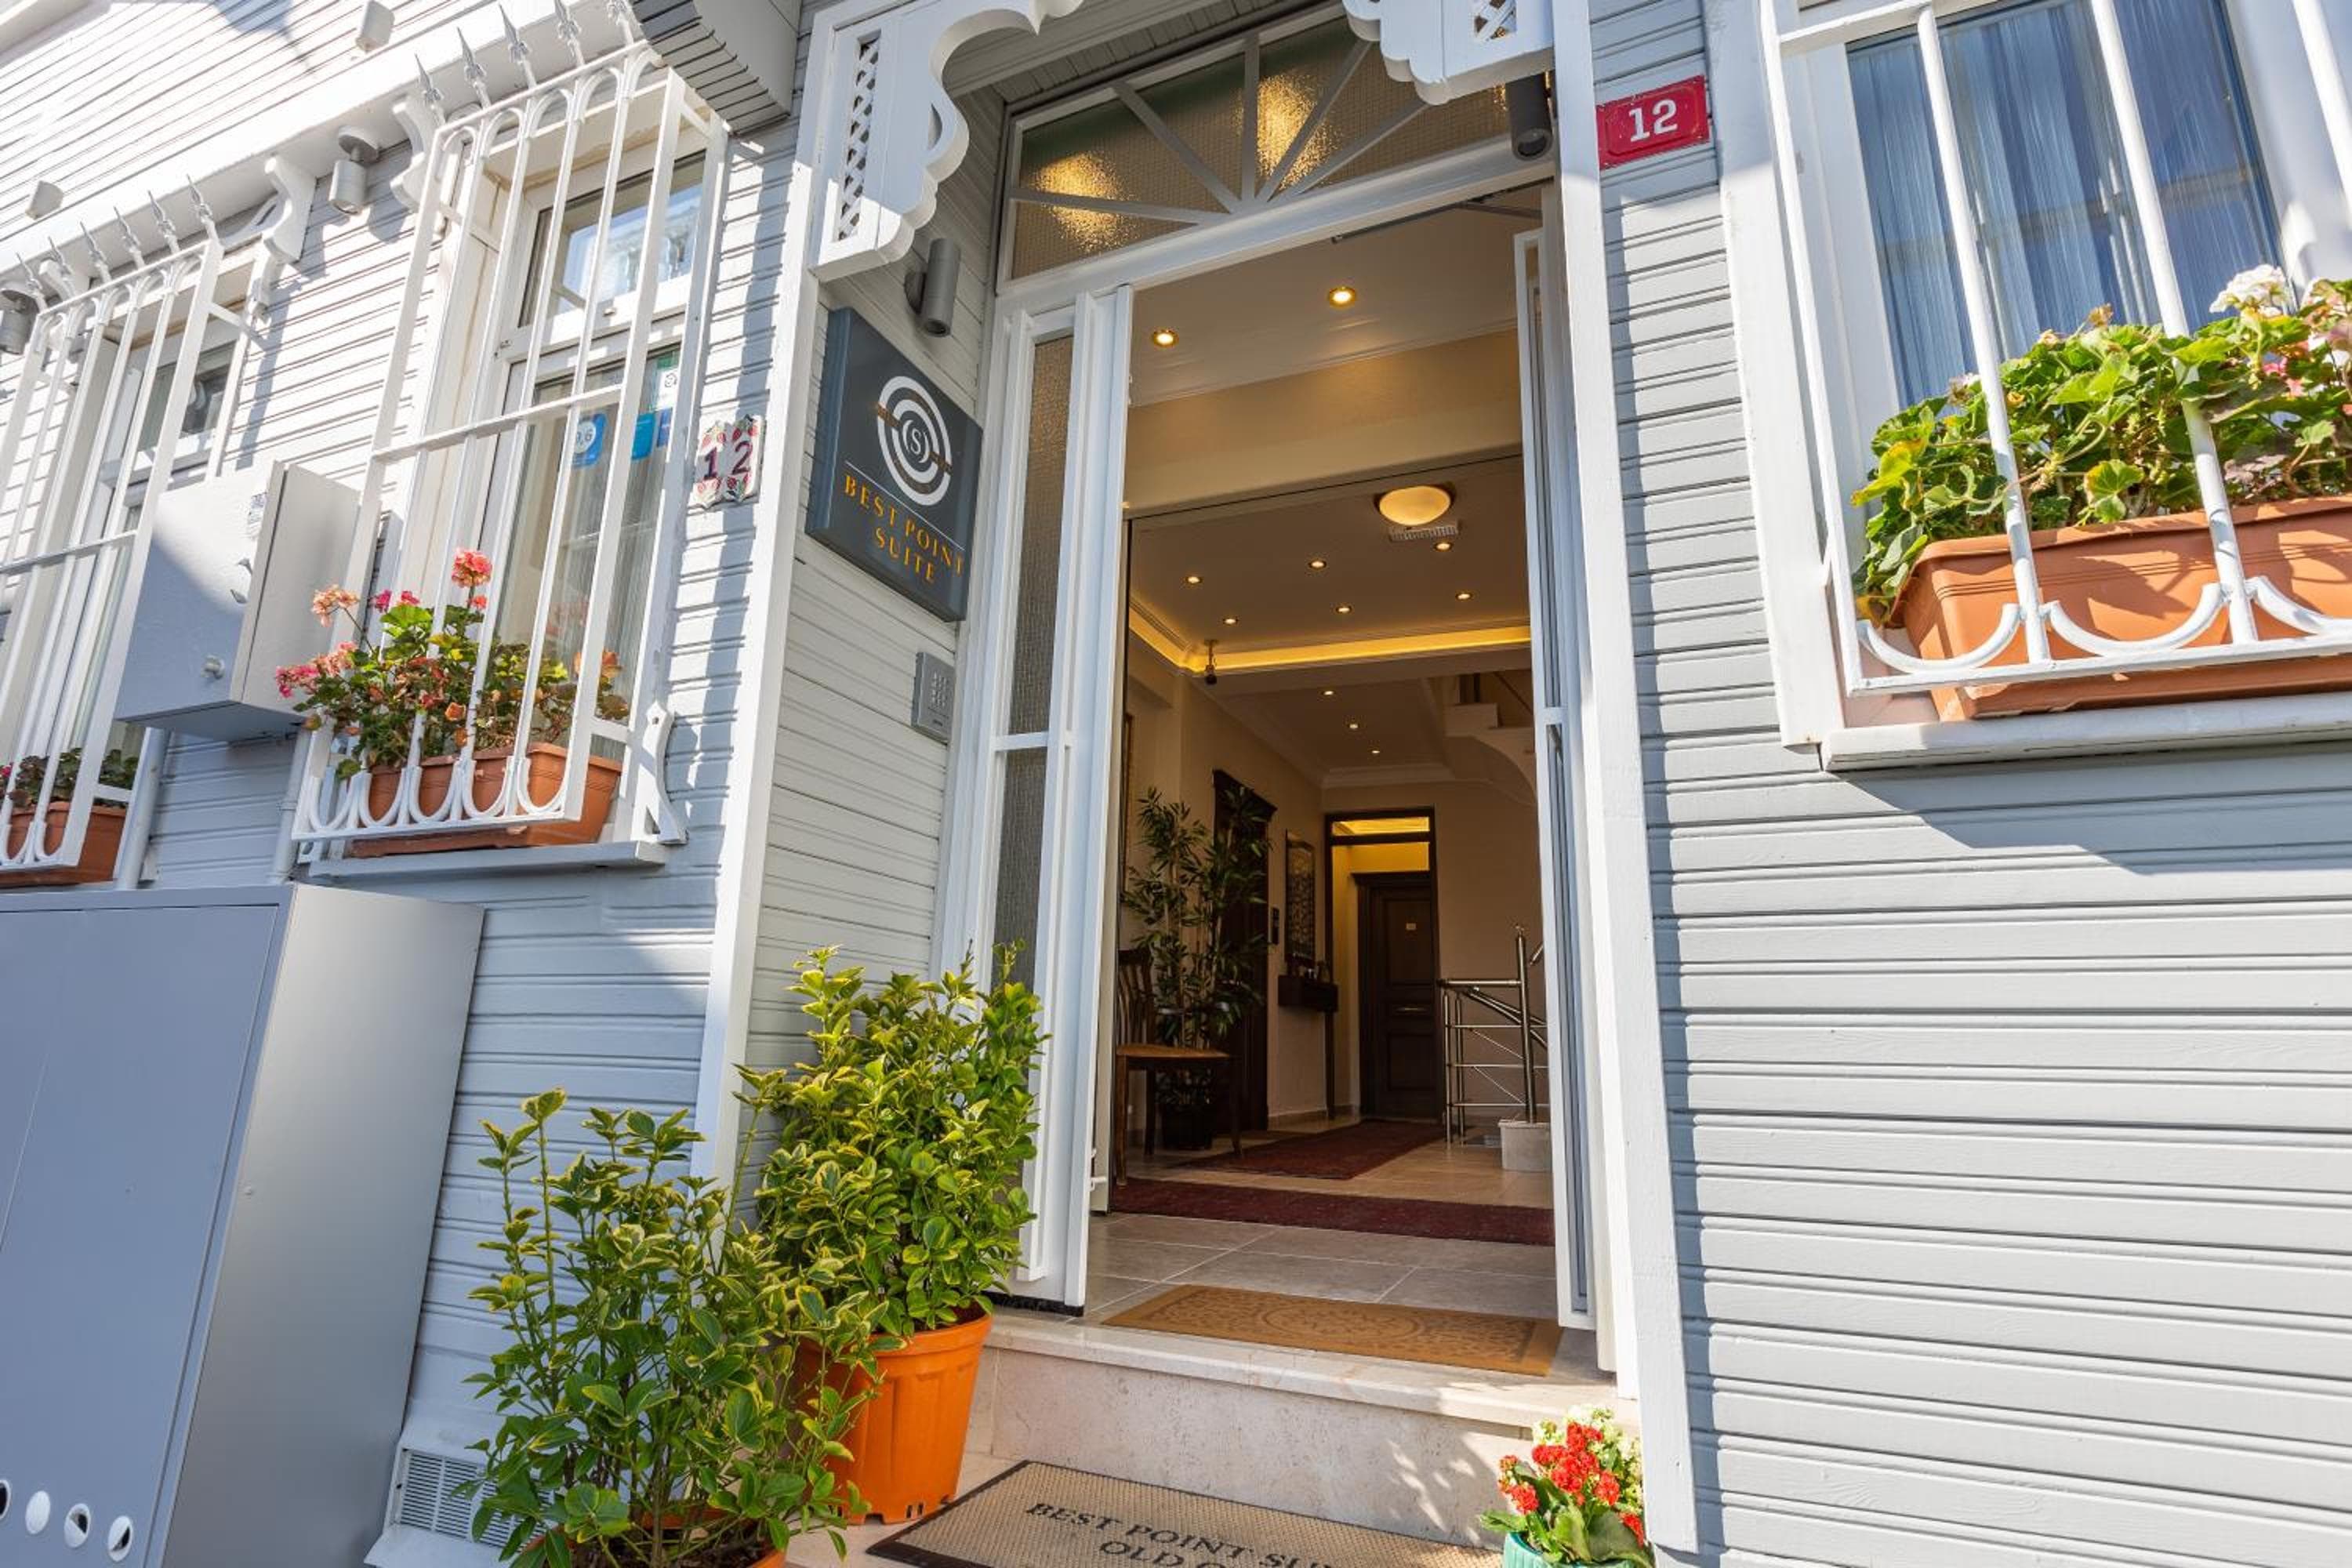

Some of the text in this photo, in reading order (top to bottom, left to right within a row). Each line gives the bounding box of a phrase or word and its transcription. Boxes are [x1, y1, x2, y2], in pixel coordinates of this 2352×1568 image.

[1628, 99, 1678, 142] 12
[703, 441, 753, 481] 12
[844, 474, 964, 576] BEST POINT
[875, 527, 935, 583] SUITE
[1026, 1503, 1123, 1530] BEST
[1125, 1524, 1254, 1559] POINT
[1099, 1541, 1185, 1567] OLD
